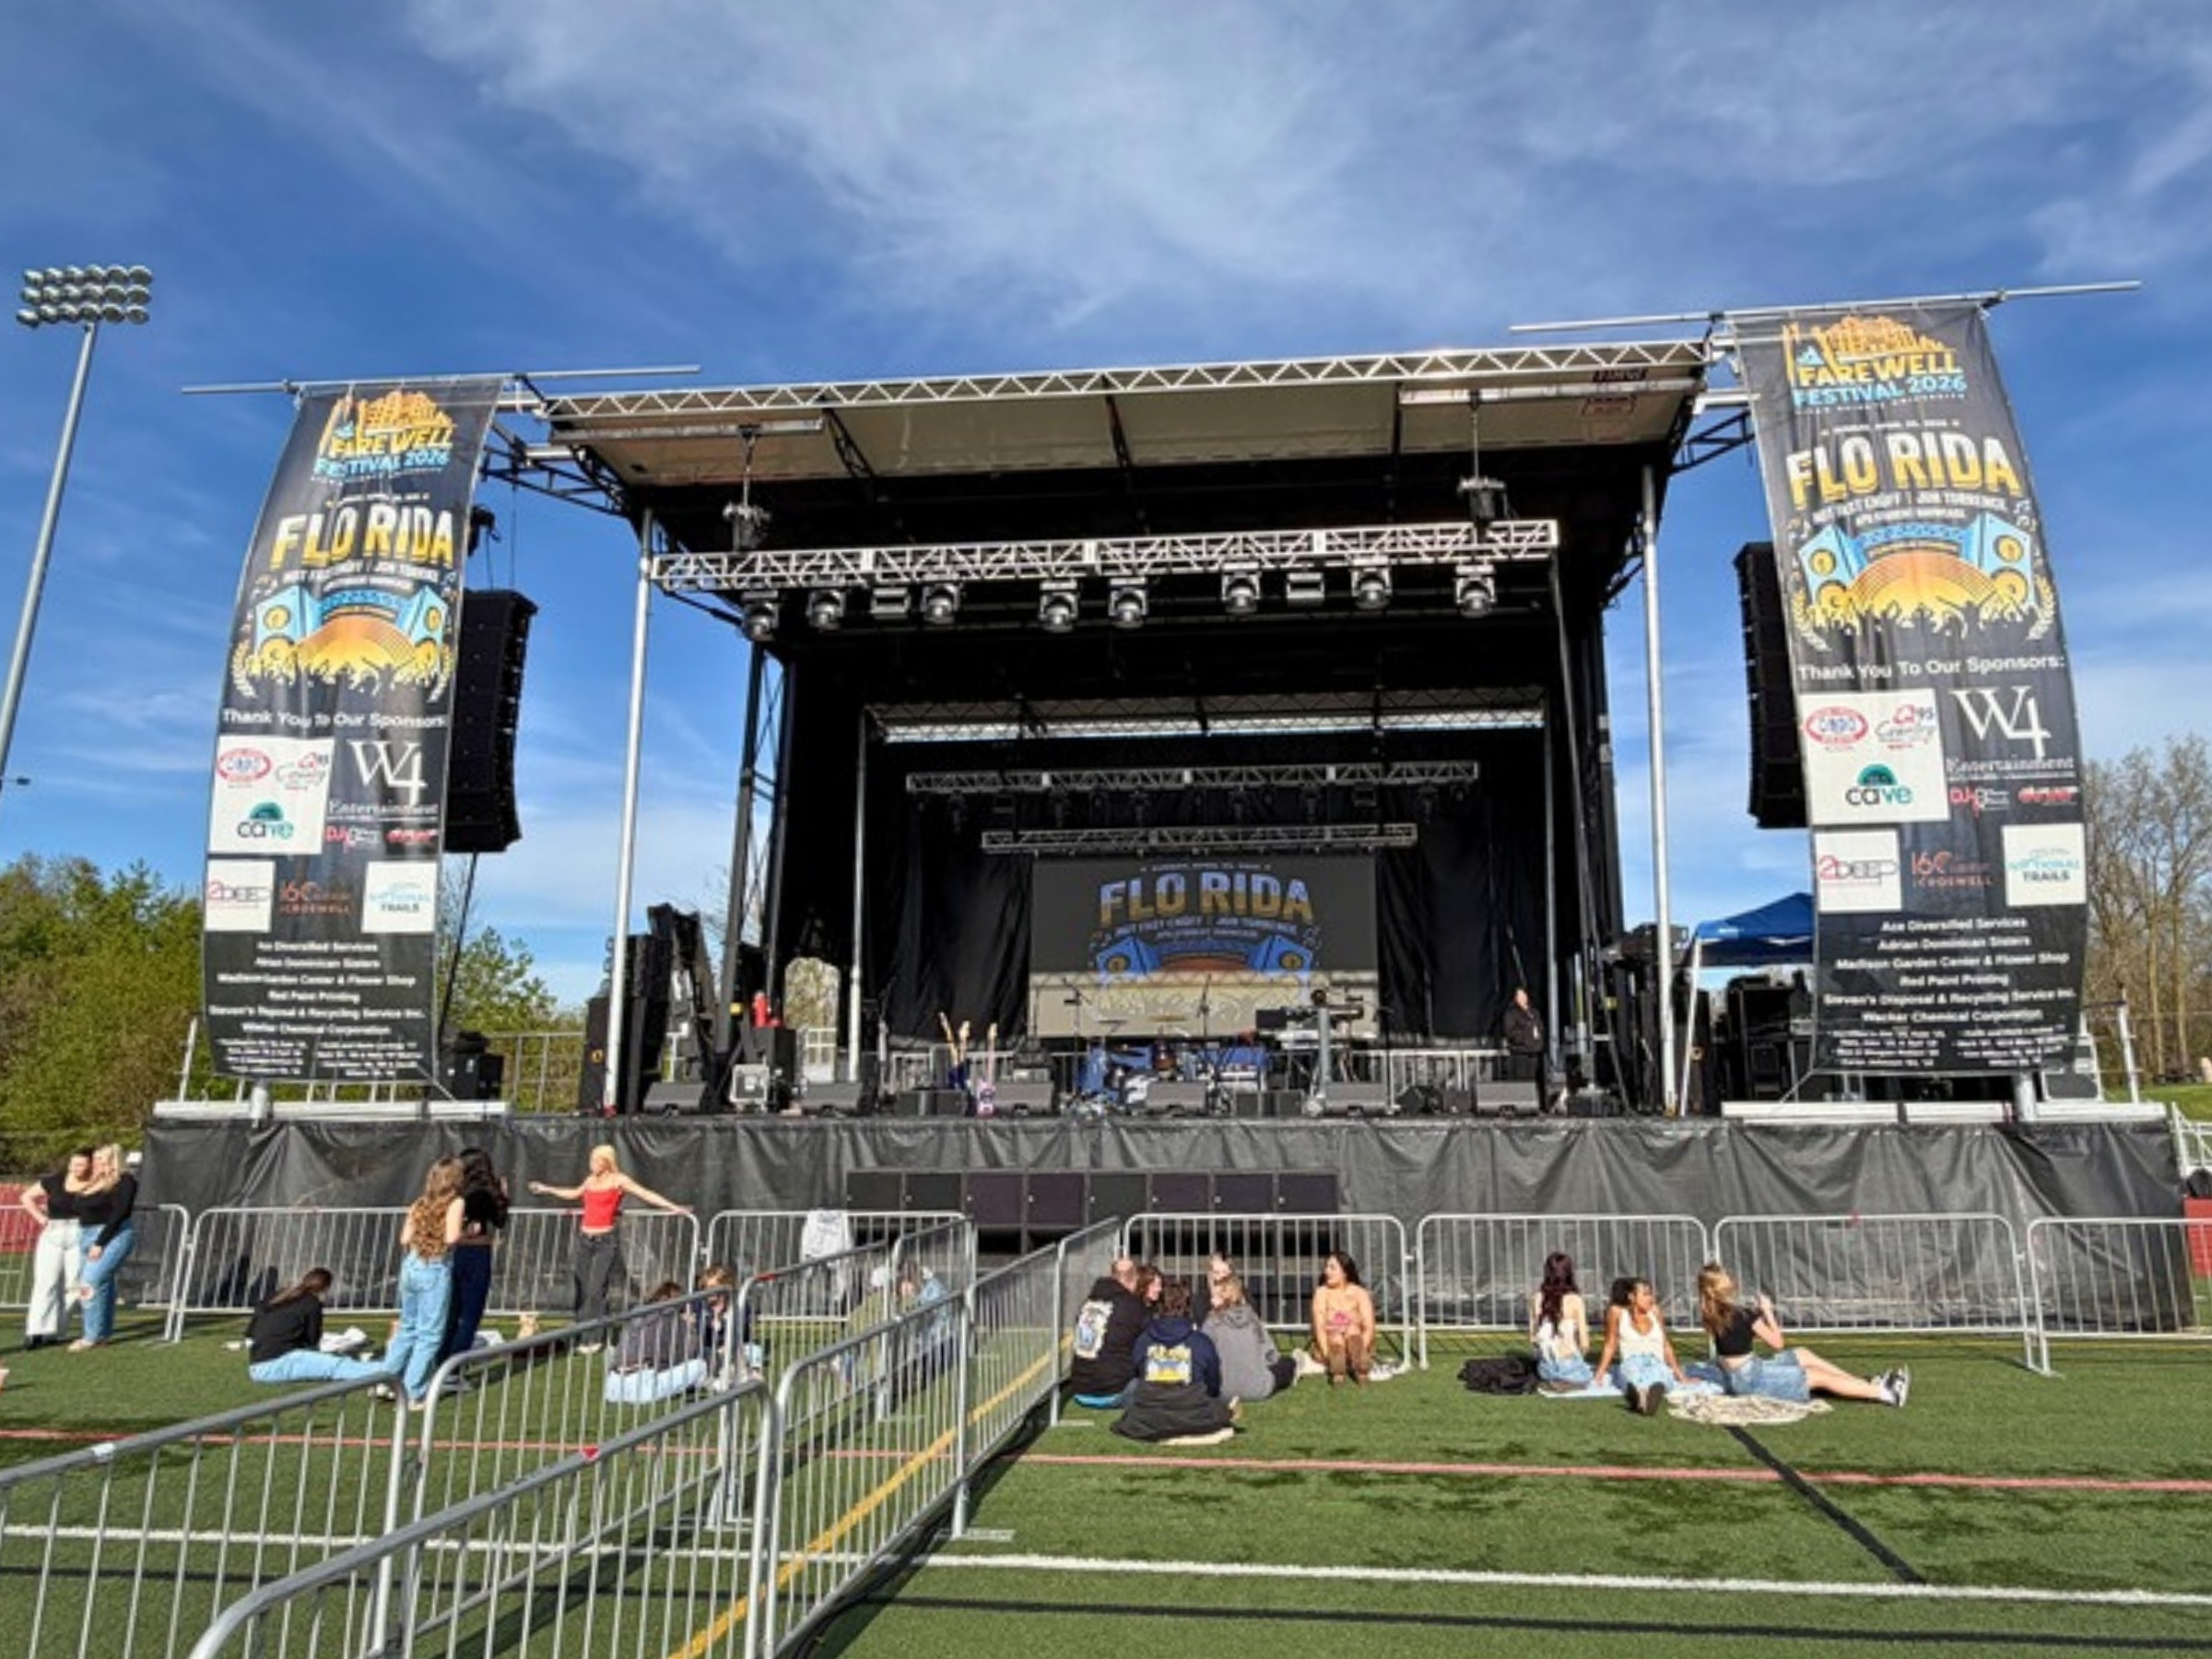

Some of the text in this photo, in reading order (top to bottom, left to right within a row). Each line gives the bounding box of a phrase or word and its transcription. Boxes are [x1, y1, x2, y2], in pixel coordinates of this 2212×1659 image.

[1798, 351, 1962, 385] FAREWELL
[1794, 381, 1905, 408] FESTIVAL
[1905, 375, 1968, 394] 2026
[1786, 436, 1878, 511] FLO
[1887, 431, 2025, 497] RIDA
[271, 503, 453, 570] FLO RIDA
[1799, 654, 2065, 680] Thank You To Our Sponsors:
[224, 709, 273, 724] Thank
[279, 712, 312, 728] You
[334, 712, 365, 727] Our
[1846, 785, 1912, 806] cave
[1100, 872, 1186, 927] FLO
[1200, 872, 1312, 923] RIDA
[1975, 917, 2028, 929] Services
